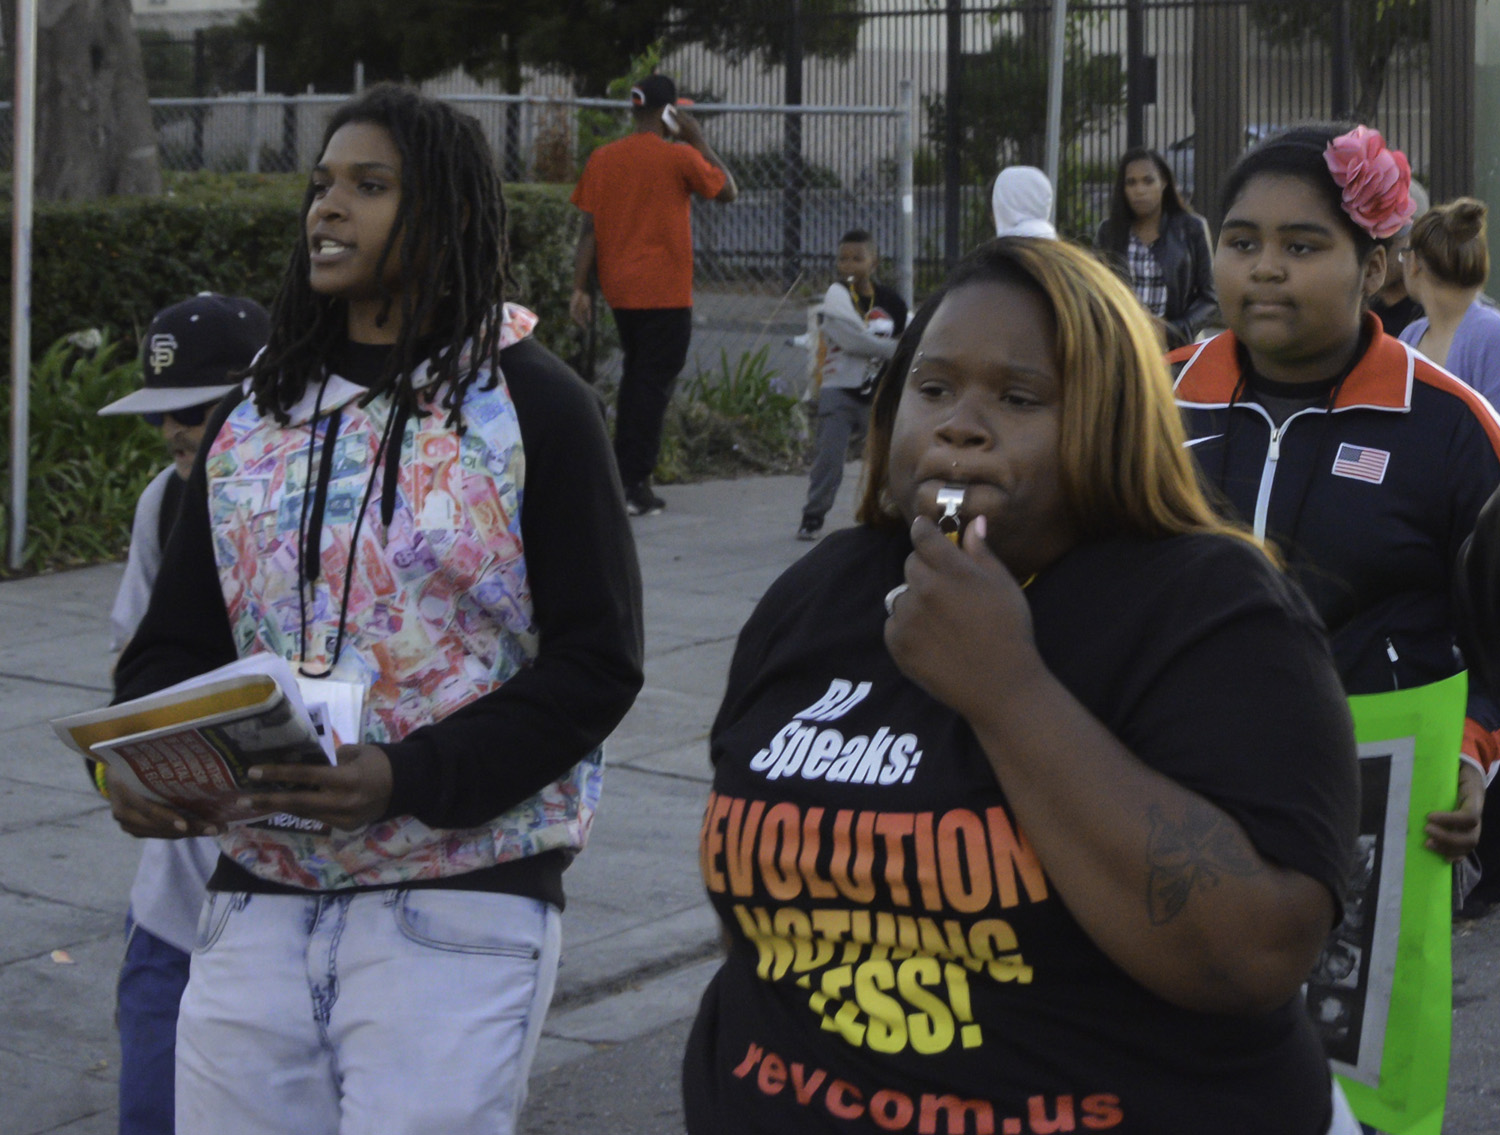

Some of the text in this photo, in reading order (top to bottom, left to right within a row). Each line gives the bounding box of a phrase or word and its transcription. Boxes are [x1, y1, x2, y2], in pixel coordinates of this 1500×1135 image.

[792, 678, 873, 723] BA
[797, 956, 983, 1055] ESS!
[732, 1042, 1125, 1135] revcom.us
